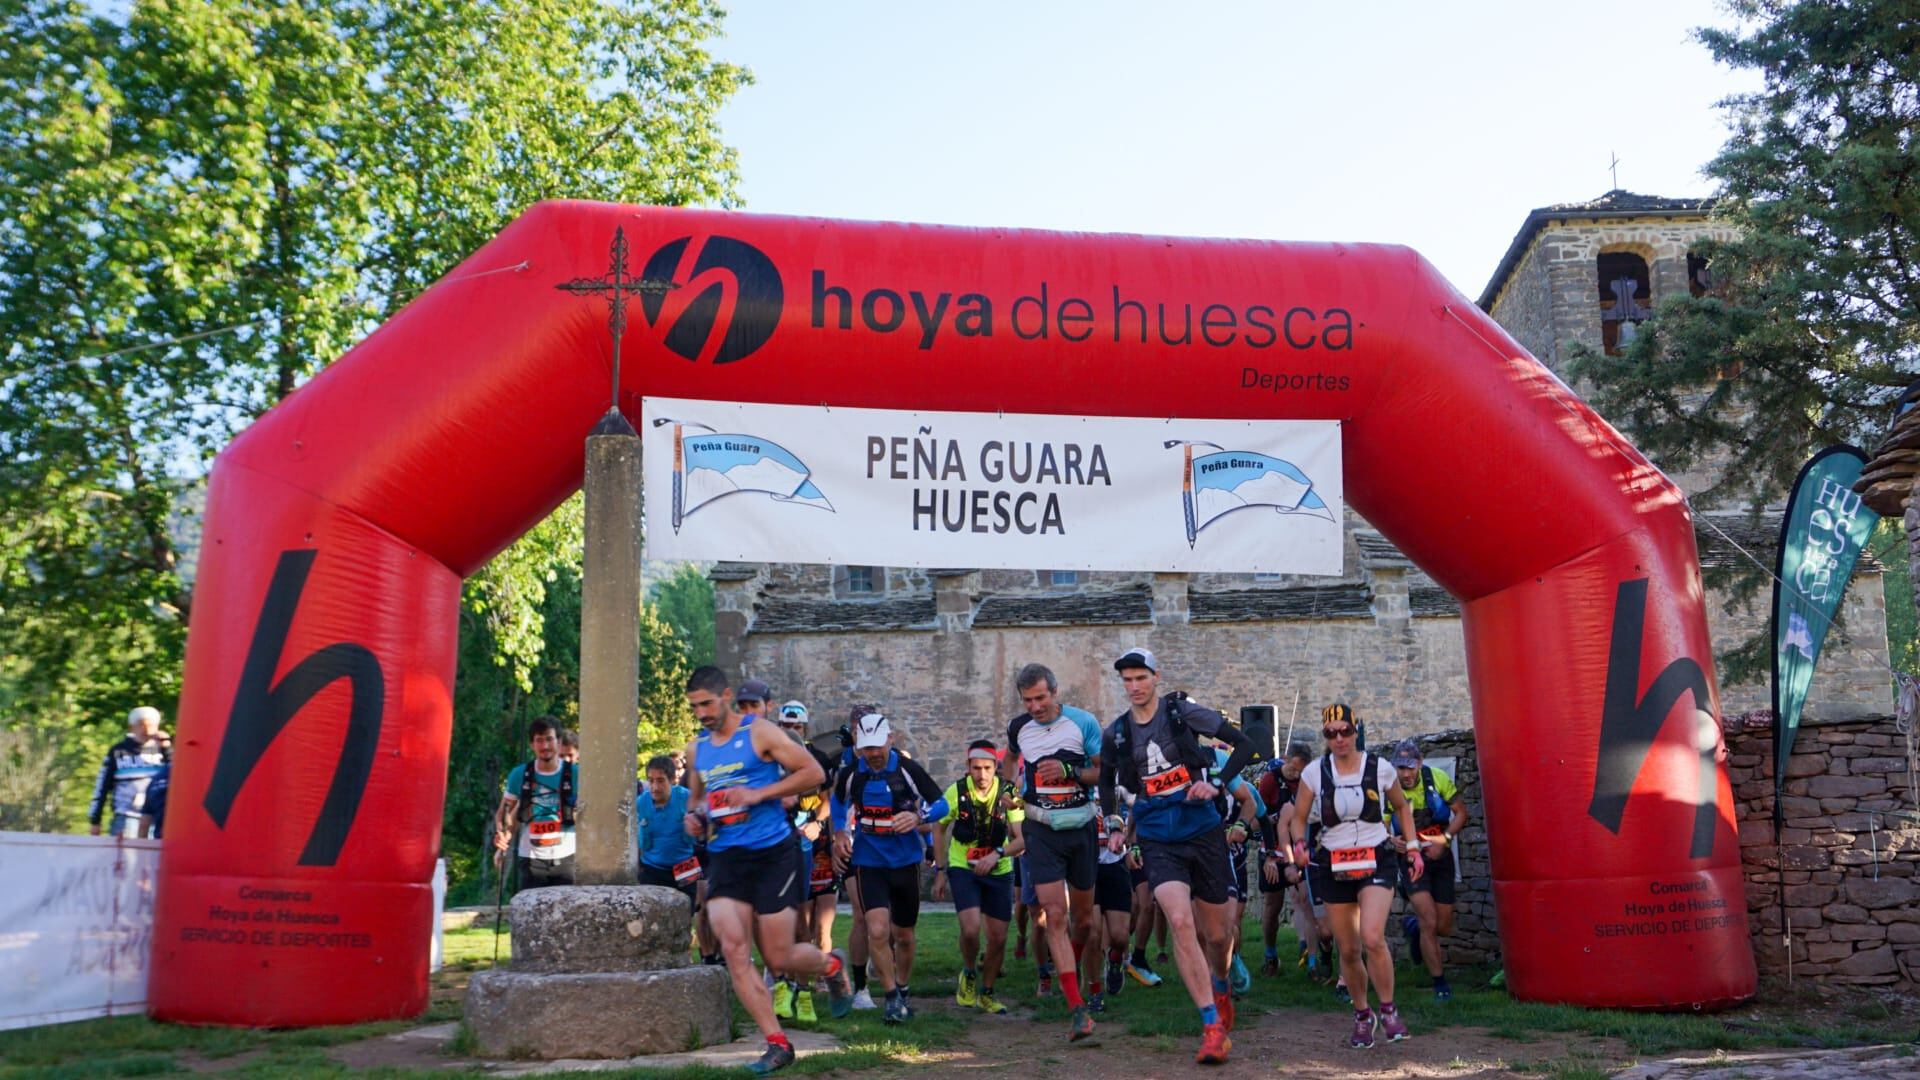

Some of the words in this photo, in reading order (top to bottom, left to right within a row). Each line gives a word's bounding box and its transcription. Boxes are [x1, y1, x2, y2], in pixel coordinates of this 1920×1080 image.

[811, 269, 993, 351] hoya
[1011, 281, 1094, 342] de
[1113, 284, 1352, 351] huesca
[1241, 367, 1350, 393] Deportes
[692, 441, 722, 453] Peña
[725, 441, 760, 454] Guara
[866, 425, 967, 482] PEÑA
[980, 440, 1112, 486] GUARA
[1201, 459, 1228, 474] Peña
[1230, 458, 1264, 470] Guara
[912, 488, 1066, 535] HUESCA
[1153, 772, 1183, 792] 244
[534, 823, 556, 834] 210
[1339, 850, 1368, 862] 222
[238, 885, 313, 902] Comarca
[1650, 880, 1709, 895] Comarca
[252, 908, 273, 923] de
[276, 910, 340, 925] Huesca
[1624, 903, 1665, 916] Hoya
[1668, 902, 1686, 914] de
[1595, 920, 1668, 938] SERVICIO
[1671, 919, 1691, 934] DE
[252, 930, 275, 946] DE
[280, 931, 372, 948] DEPORTES
